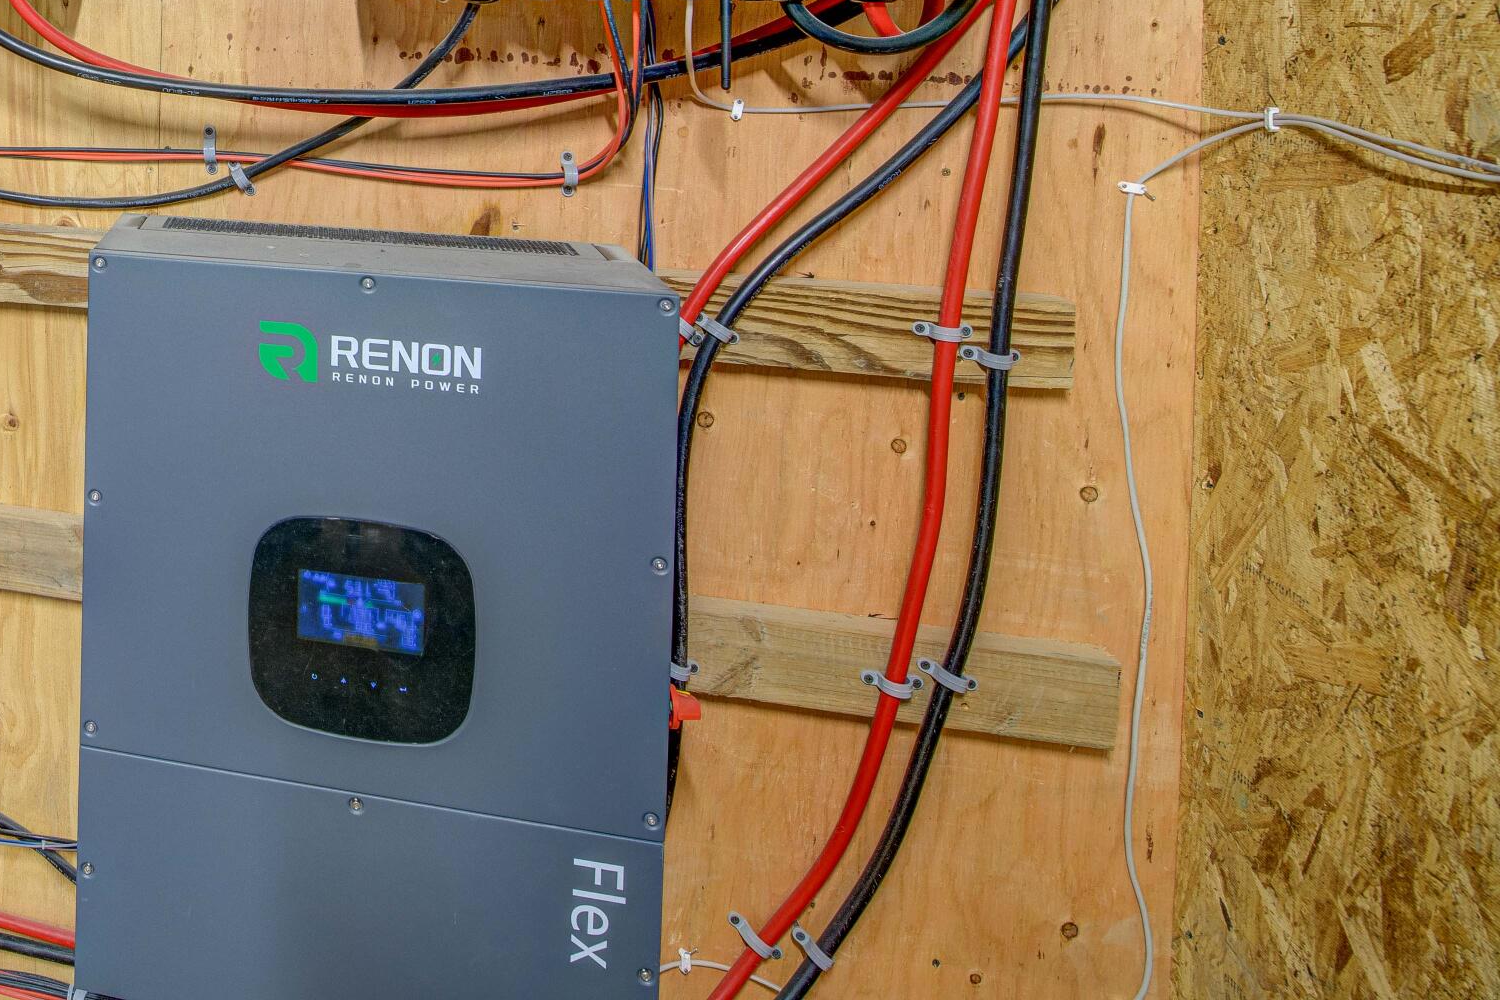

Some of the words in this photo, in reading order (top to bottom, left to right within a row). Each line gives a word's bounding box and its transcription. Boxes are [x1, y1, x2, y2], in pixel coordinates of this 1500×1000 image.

[330, 335, 482, 379] RENON
[332, 372, 394, 387] RENON
[411, 378, 479, 395] POWER
[570, 858, 626, 969] Flex
